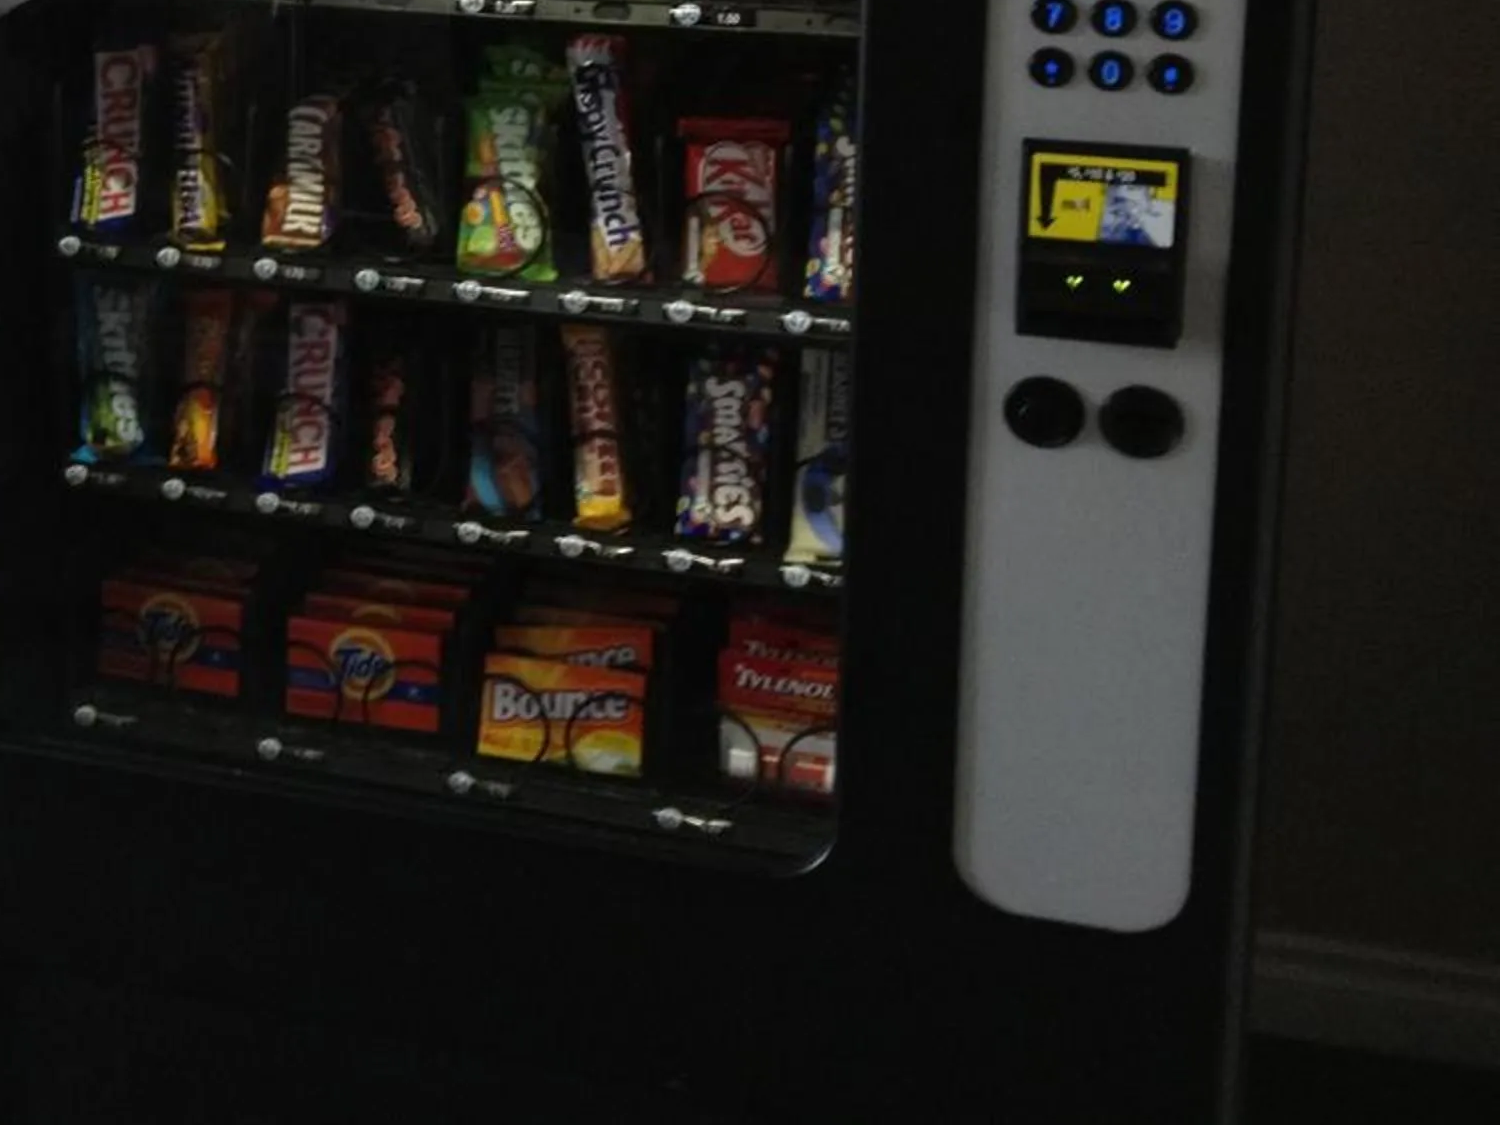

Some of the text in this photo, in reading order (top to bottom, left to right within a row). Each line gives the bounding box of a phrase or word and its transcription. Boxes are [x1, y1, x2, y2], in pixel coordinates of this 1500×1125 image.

[1047, 2, 1063, 27] 7
[1104, 5, 1122, 31] 8
[1164, 8, 1185, 35] 9
[1101, 59, 1120, 85] 0
[99, 55, 138, 216] CRUNCH
[281, 104, 328, 235] CARAMILK
[590, 144, 642, 247] Crunch
[291, 308, 332, 467] CRUNCH
[733, 663, 837, 700] TYLENOL
[493, 682, 628, 721] Bounce
